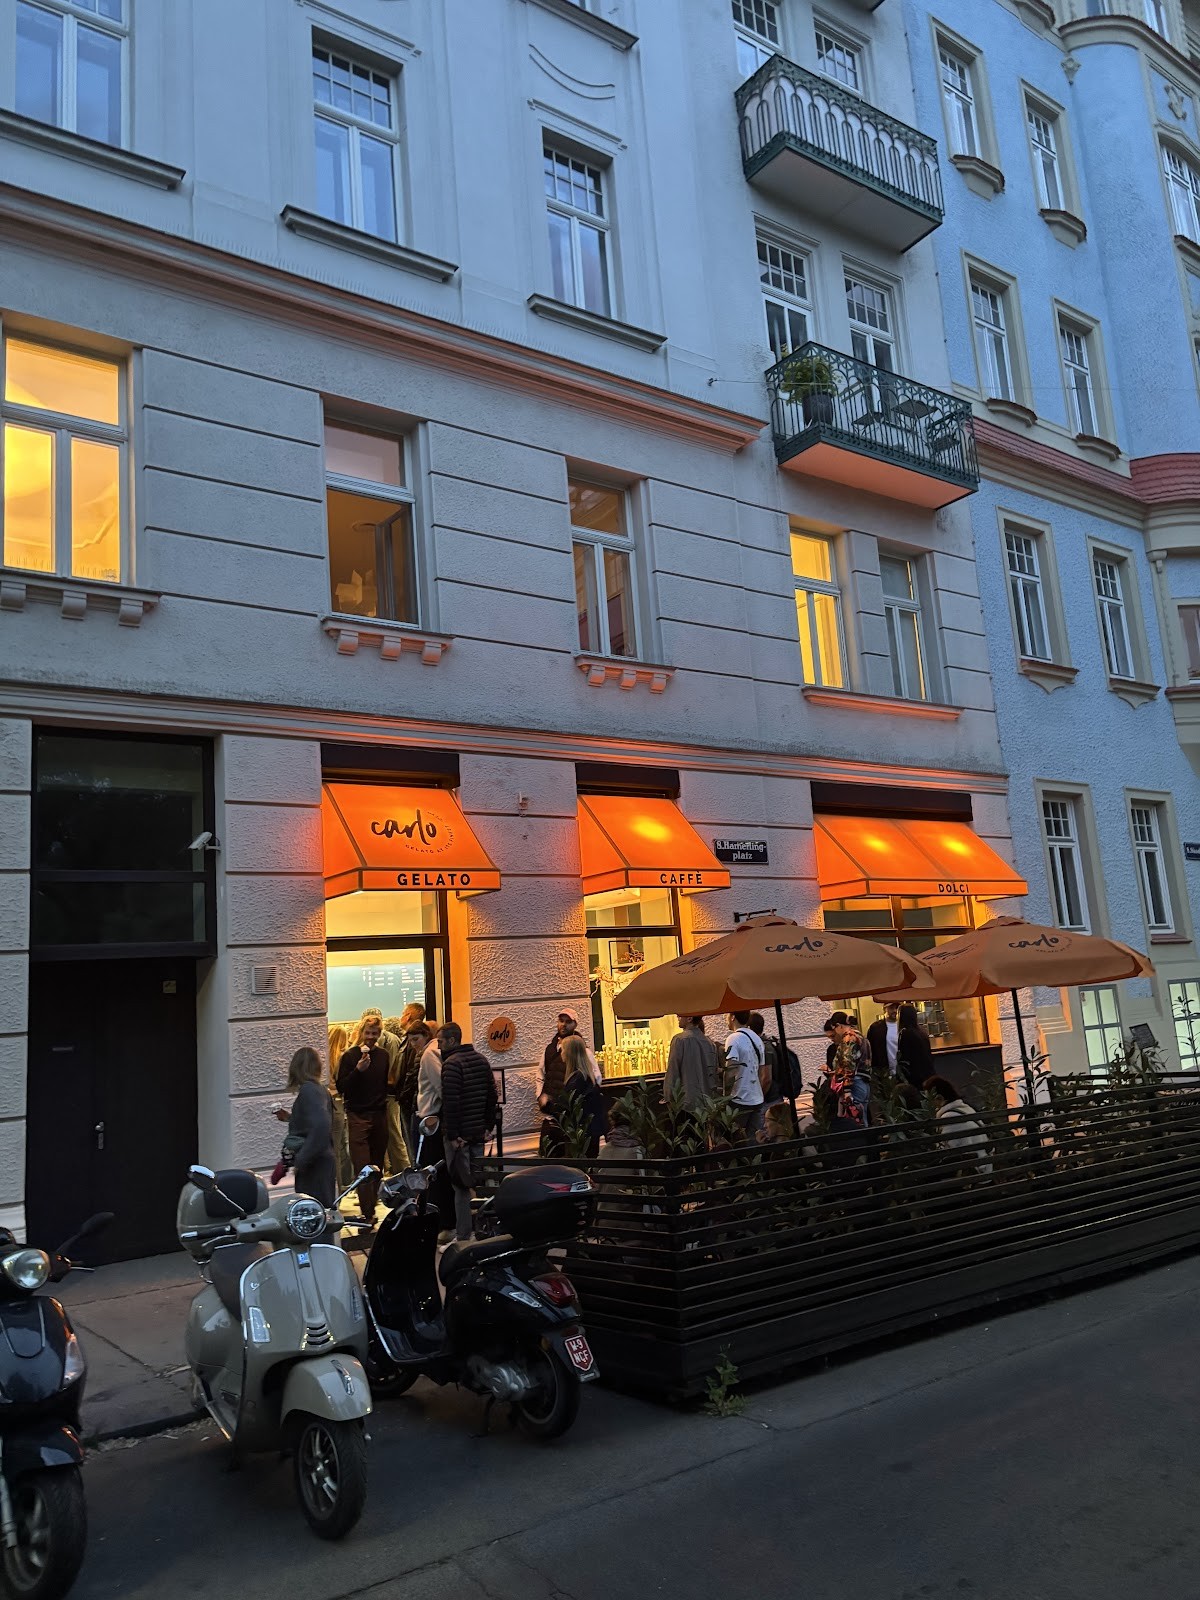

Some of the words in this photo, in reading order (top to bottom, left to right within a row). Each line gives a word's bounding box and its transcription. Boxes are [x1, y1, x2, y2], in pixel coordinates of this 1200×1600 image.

[371, 809, 437, 845] carlo
[732, 851, 753, 861] platz
[397, 873, 471, 886] GELATO
[660, 870, 702, 884] CAFFÈ
[938, 883, 969, 893] DOLCI
[765, 936, 823, 952] carlo
[1008, 933, 1059, 948] carlo
[490, 1023, 510, 1042] carlo
